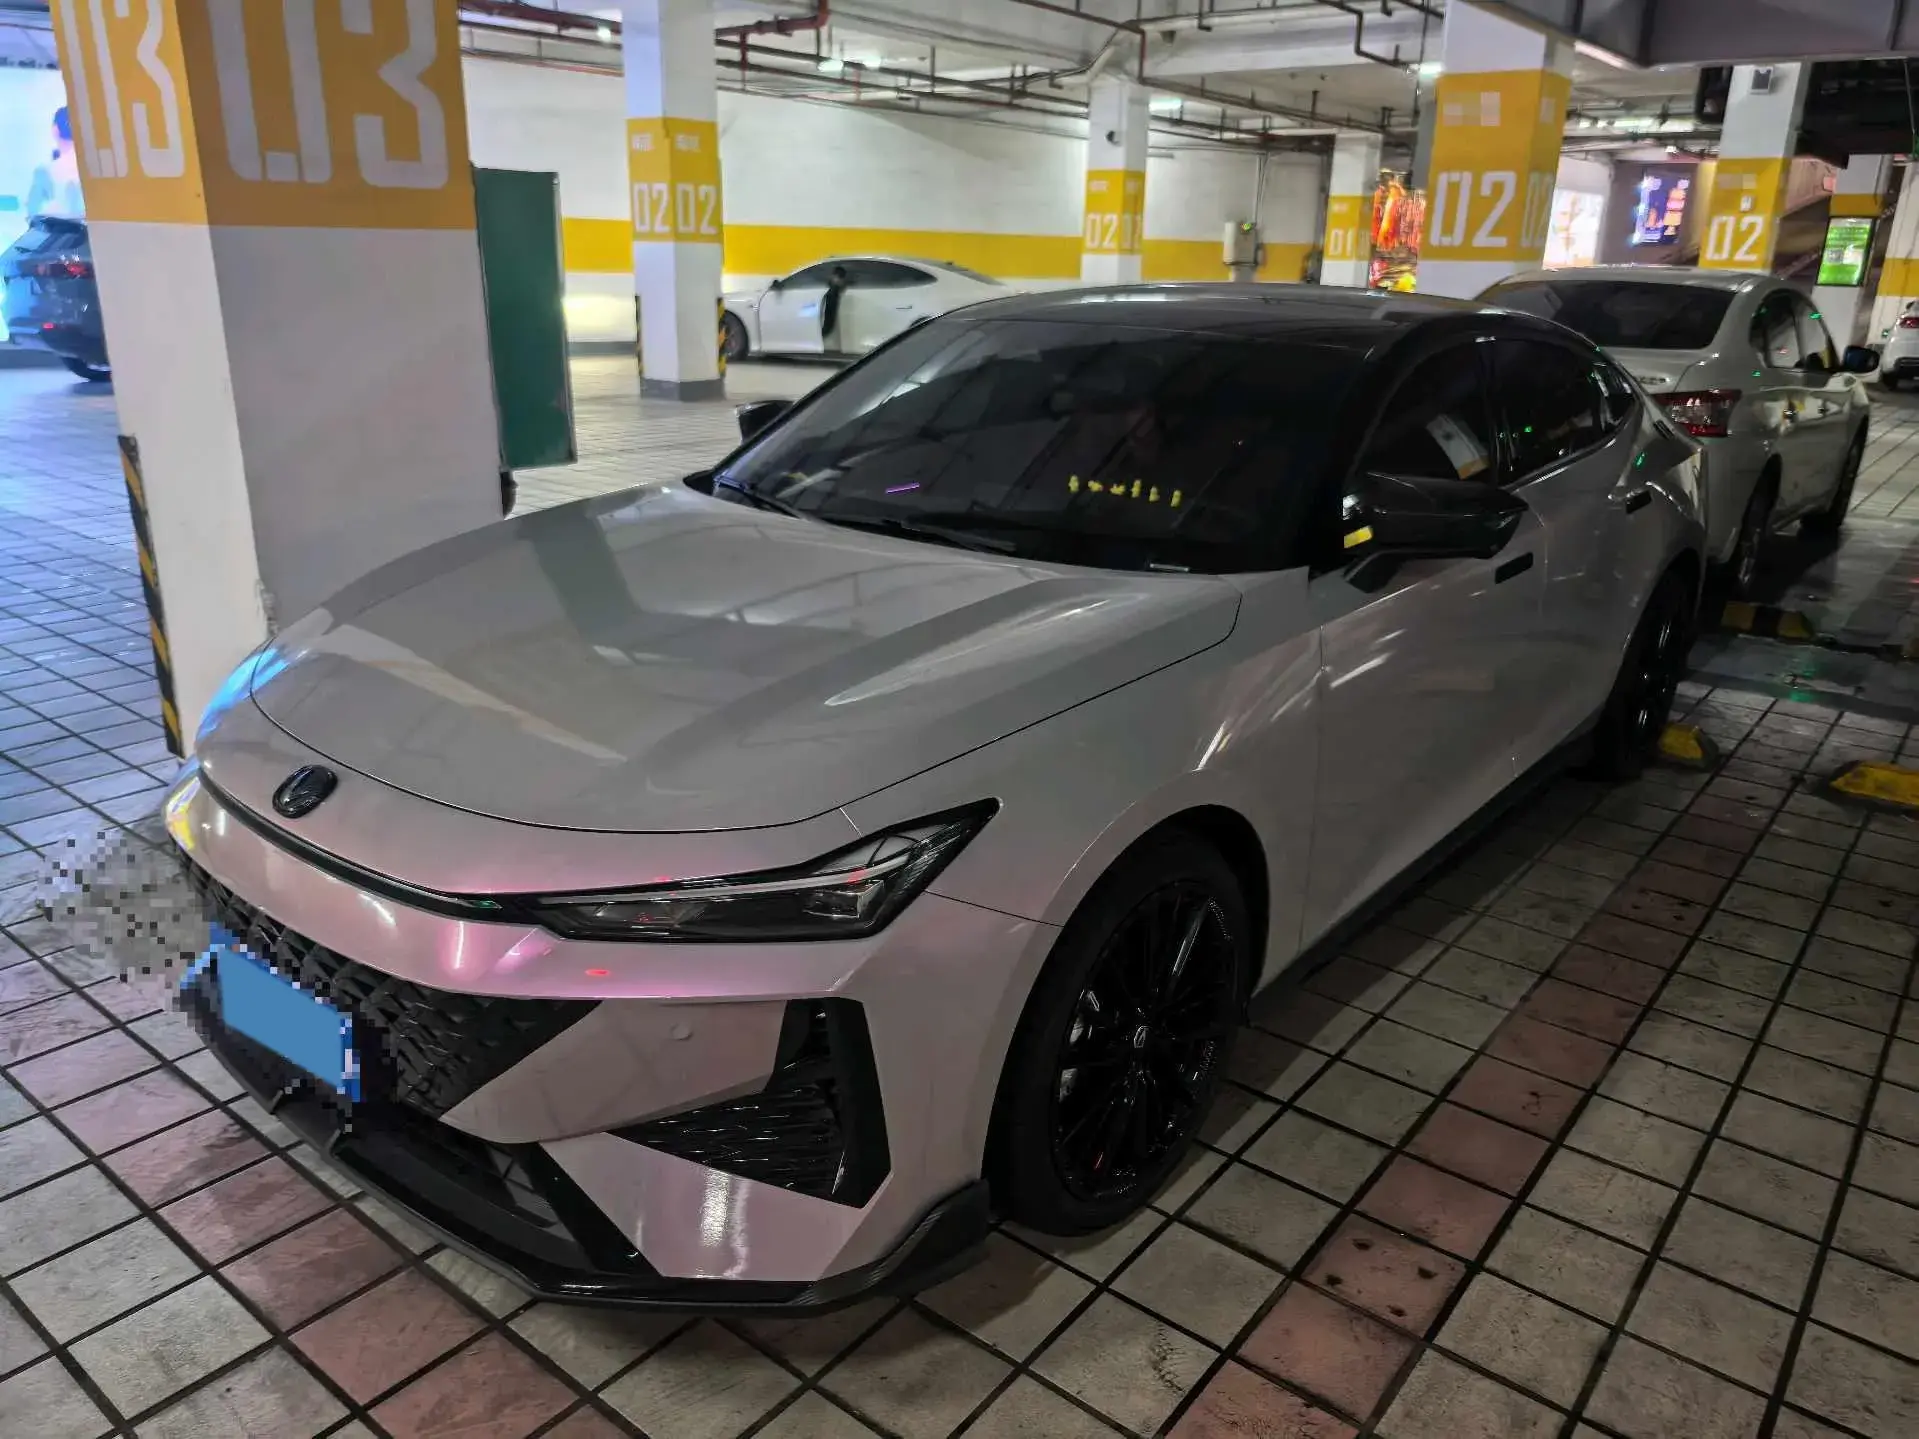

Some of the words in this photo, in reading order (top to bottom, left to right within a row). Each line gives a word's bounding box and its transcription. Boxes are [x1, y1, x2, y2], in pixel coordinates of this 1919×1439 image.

[207, 0, 449, 189] 03
[633, 183, 670, 233] 02
[676, 184, 717, 234] 02
[1086, 213, 1118, 249] 02
[1429, 171, 1517, 247] 02
[1706, 215, 1763, 260] 02
